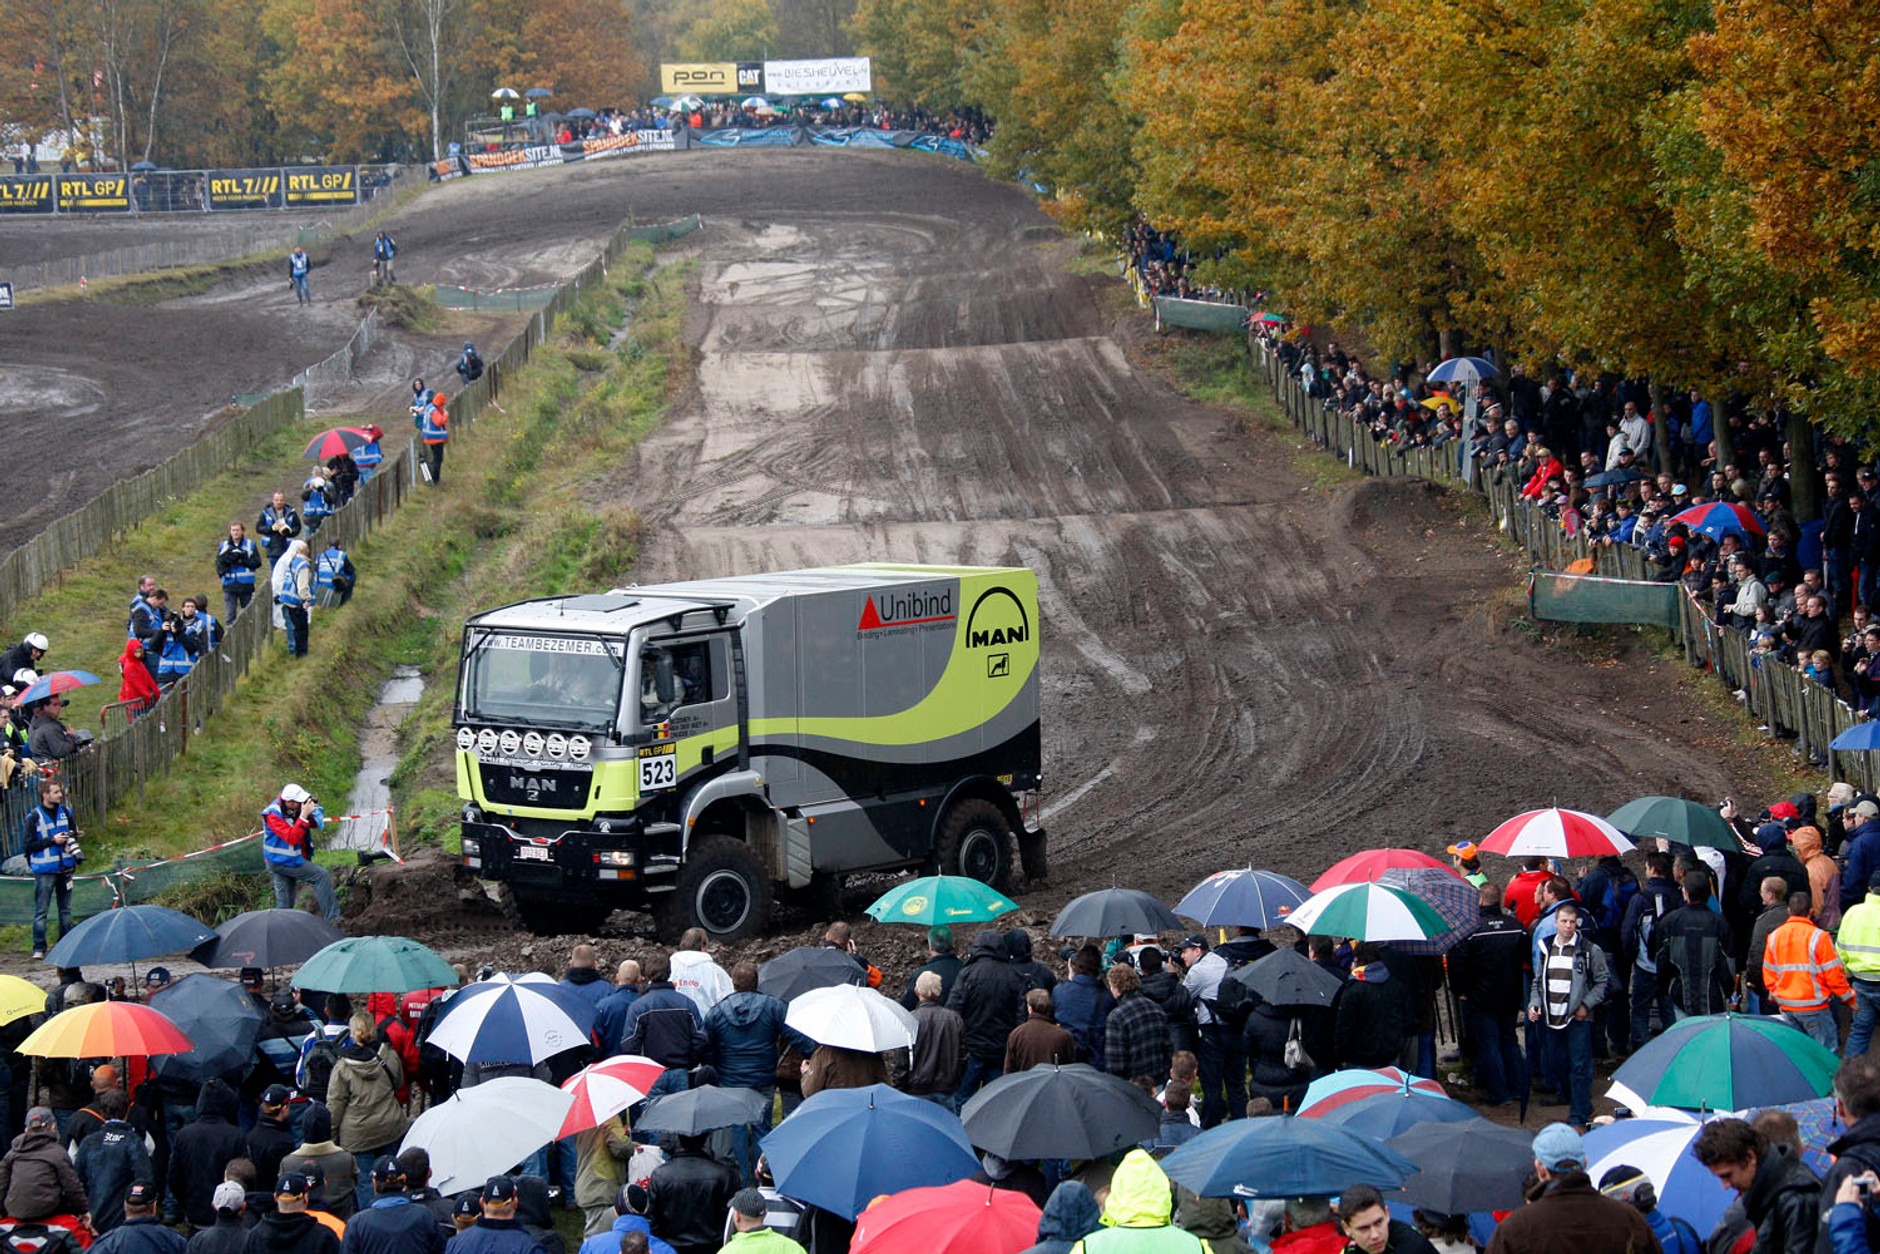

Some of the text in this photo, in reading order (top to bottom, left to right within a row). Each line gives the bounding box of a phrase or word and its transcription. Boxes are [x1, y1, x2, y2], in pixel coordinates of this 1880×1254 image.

[674, 71, 725, 85] pon
[738, 69, 760, 86] CAT
[469, 144, 563, 169] SPANDOEKSITE.NL
[60, 181, 92, 196] RTL
[211, 178, 242, 195] RTL
[289, 174, 319, 189] RTL
[880, 588, 951, 621] Unibind
[972, 626, 1024, 648] MAN
[643, 759, 674, 786] 523
[510, 776, 557, 792] MAN
